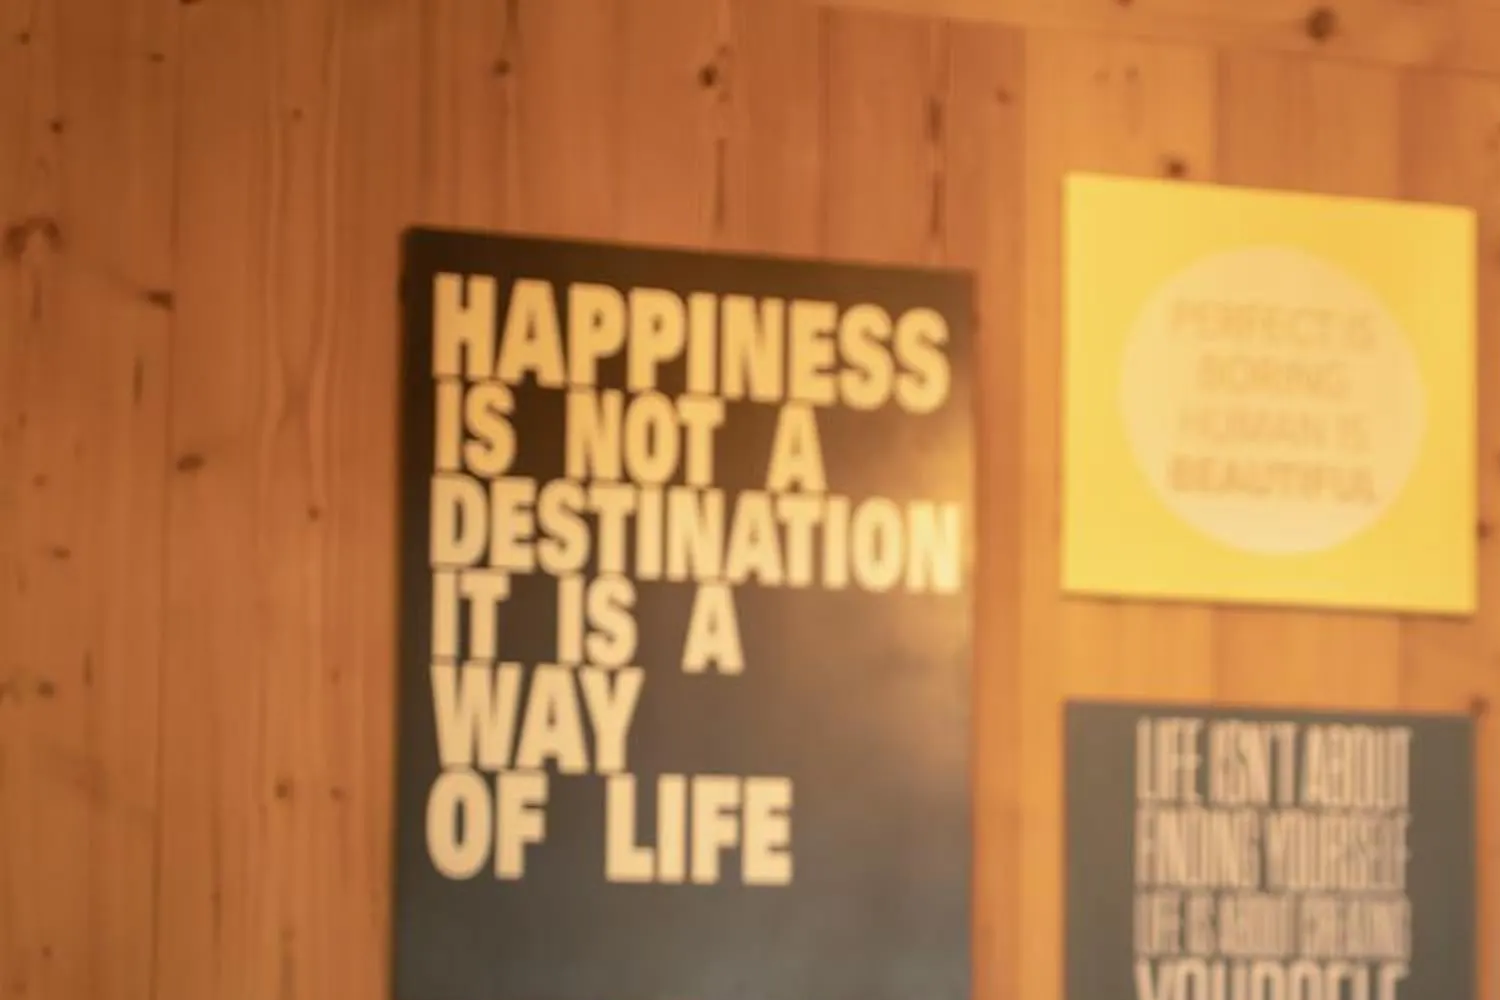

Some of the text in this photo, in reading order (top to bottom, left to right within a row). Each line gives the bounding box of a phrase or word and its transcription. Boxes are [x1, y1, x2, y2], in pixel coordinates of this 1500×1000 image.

[433, 272, 951, 414] HAPPINESS
[434, 379, 826, 492] IS NOT A
[430, 474, 962, 593] DESTINATION
[432, 569, 745, 674] IT IS A
[430, 663, 644, 774] WAY
[1136, 715, 1204, 802] LIFE
[1301, 724, 1413, 808] ABOUT
[425, 770, 793, 884] OF LIFE
